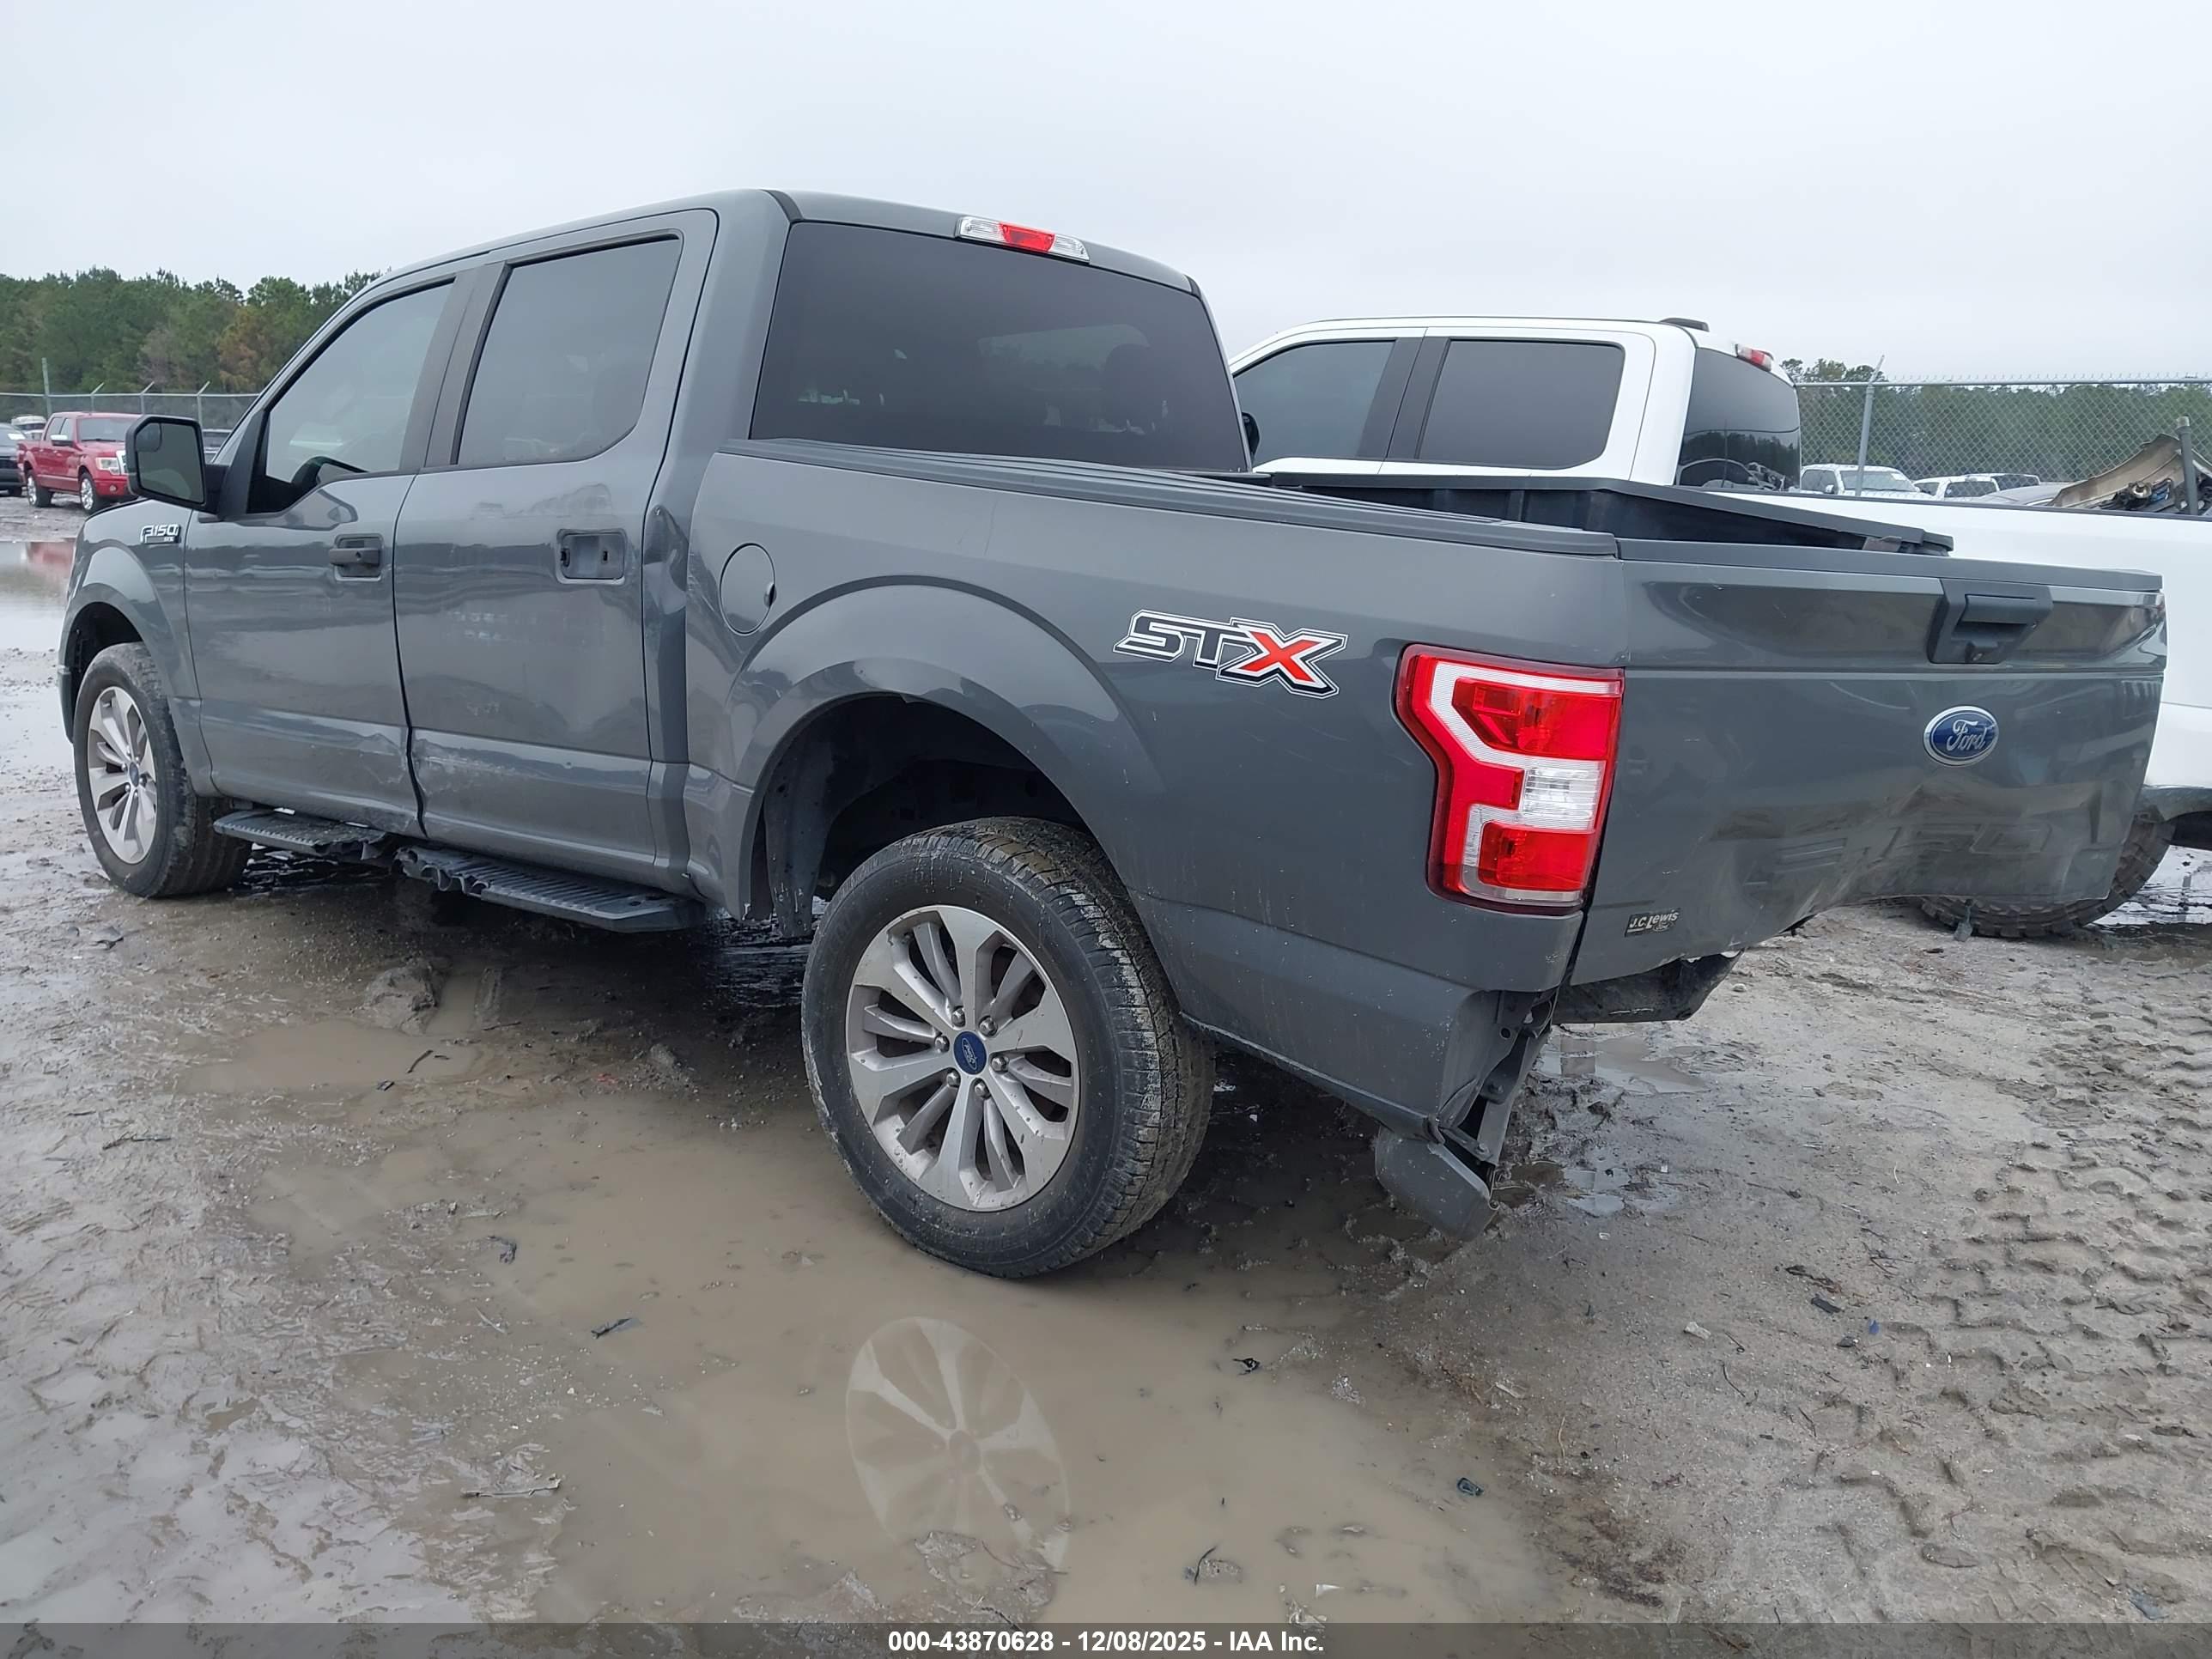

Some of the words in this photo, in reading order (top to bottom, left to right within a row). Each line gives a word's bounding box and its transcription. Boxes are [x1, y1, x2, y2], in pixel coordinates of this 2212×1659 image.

[140, 524, 179, 544] F150
[1113, 609, 1348, 699] STX
[1946, 718, 1995, 751] Ford
